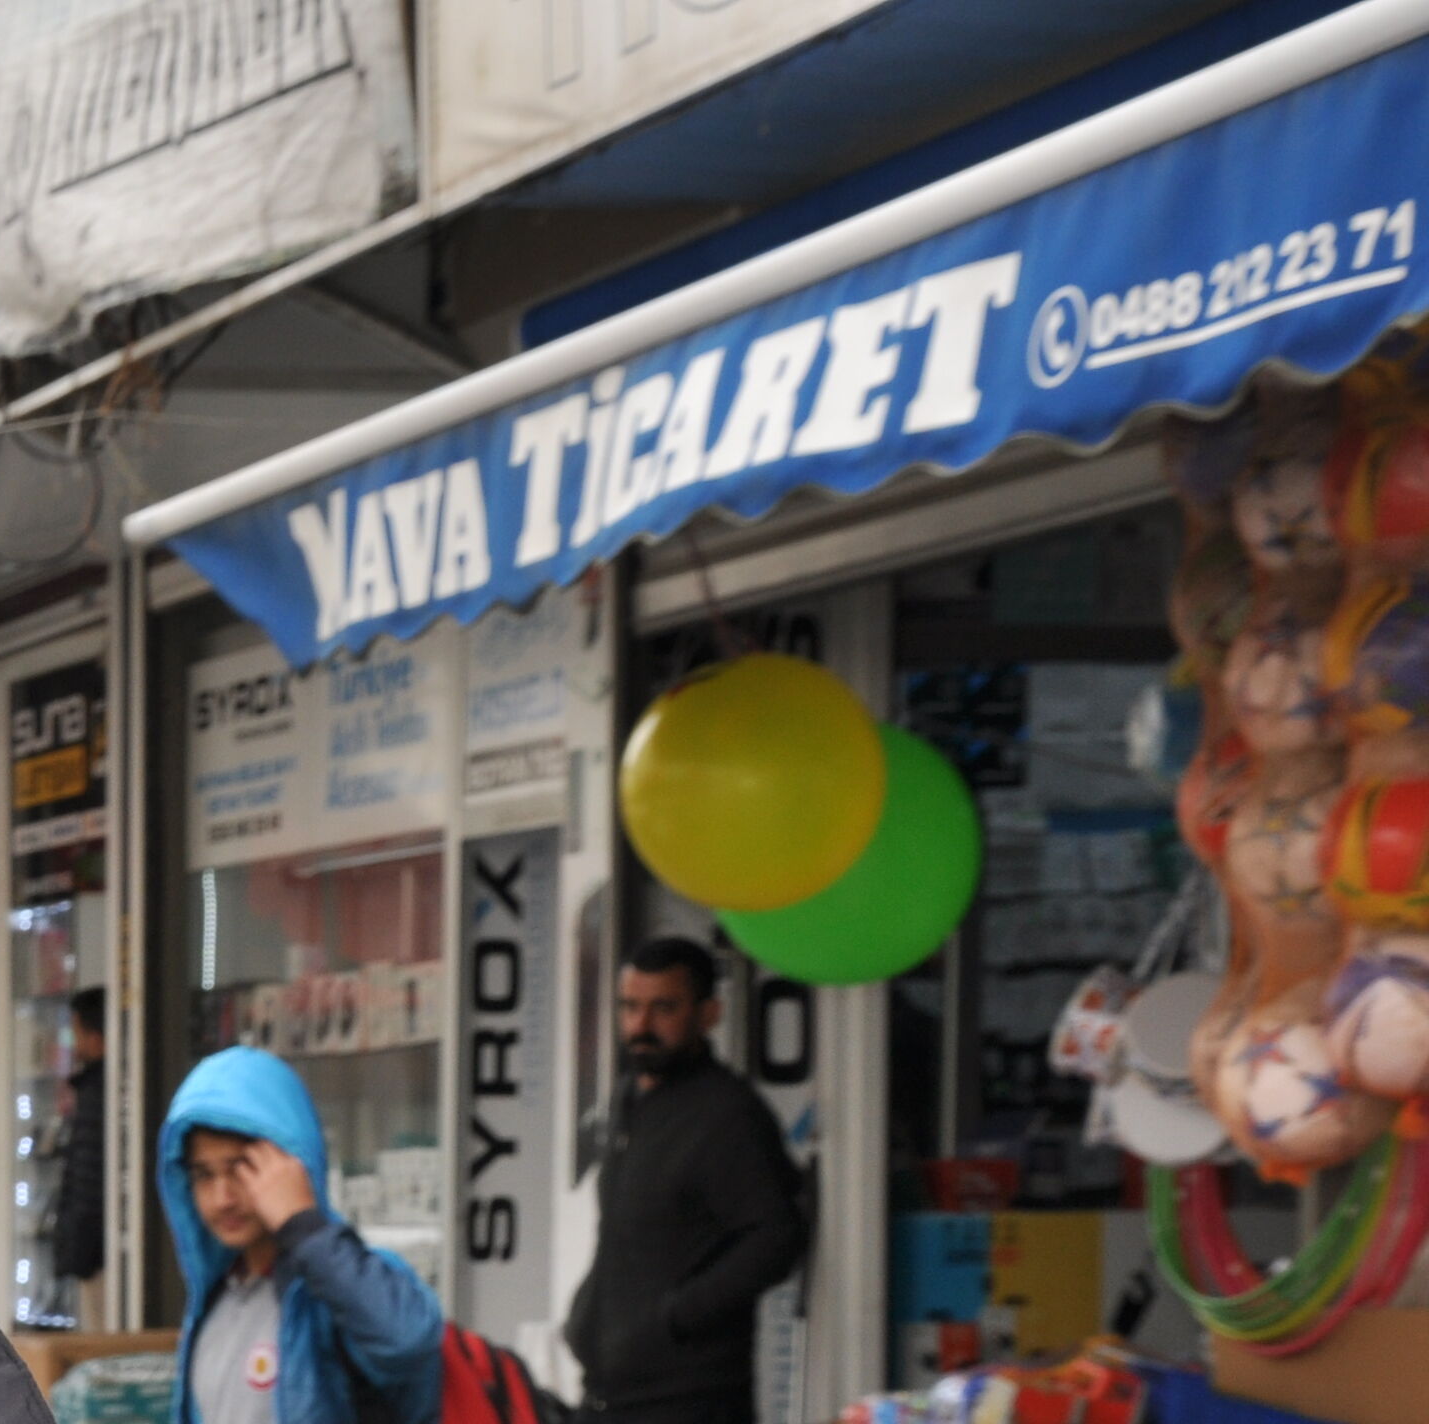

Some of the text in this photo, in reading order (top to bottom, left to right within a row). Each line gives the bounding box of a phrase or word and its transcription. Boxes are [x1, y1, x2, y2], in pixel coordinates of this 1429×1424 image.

[287, 250, 1024, 642] YAVA TİCARET
[1089, 199, 1416, 349] 0488 212 23 71
[466, 853, 525, 1263] SYROX
